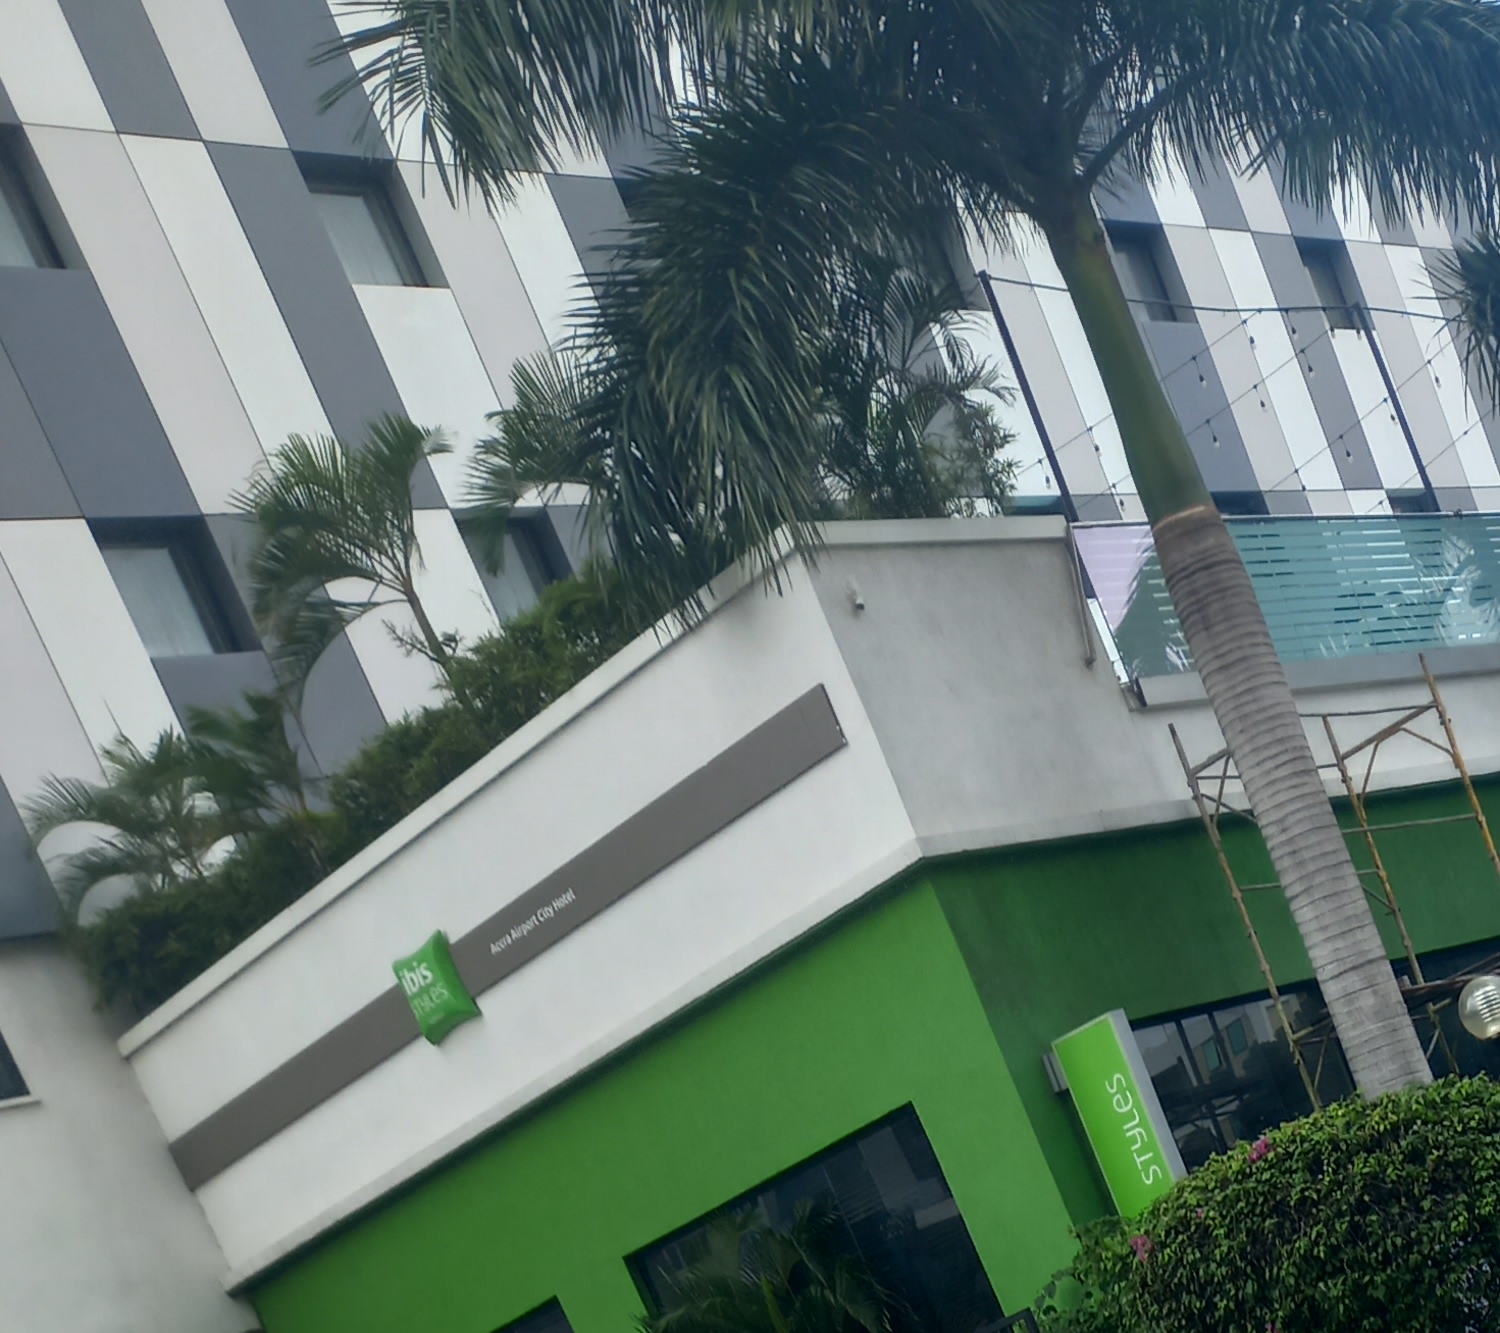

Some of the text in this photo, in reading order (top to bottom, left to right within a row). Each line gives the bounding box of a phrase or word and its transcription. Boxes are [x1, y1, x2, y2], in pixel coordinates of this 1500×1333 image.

[490, 887, 576, 955] Accra Airport City Hotel
[399, 961, 433, 996] ibis
